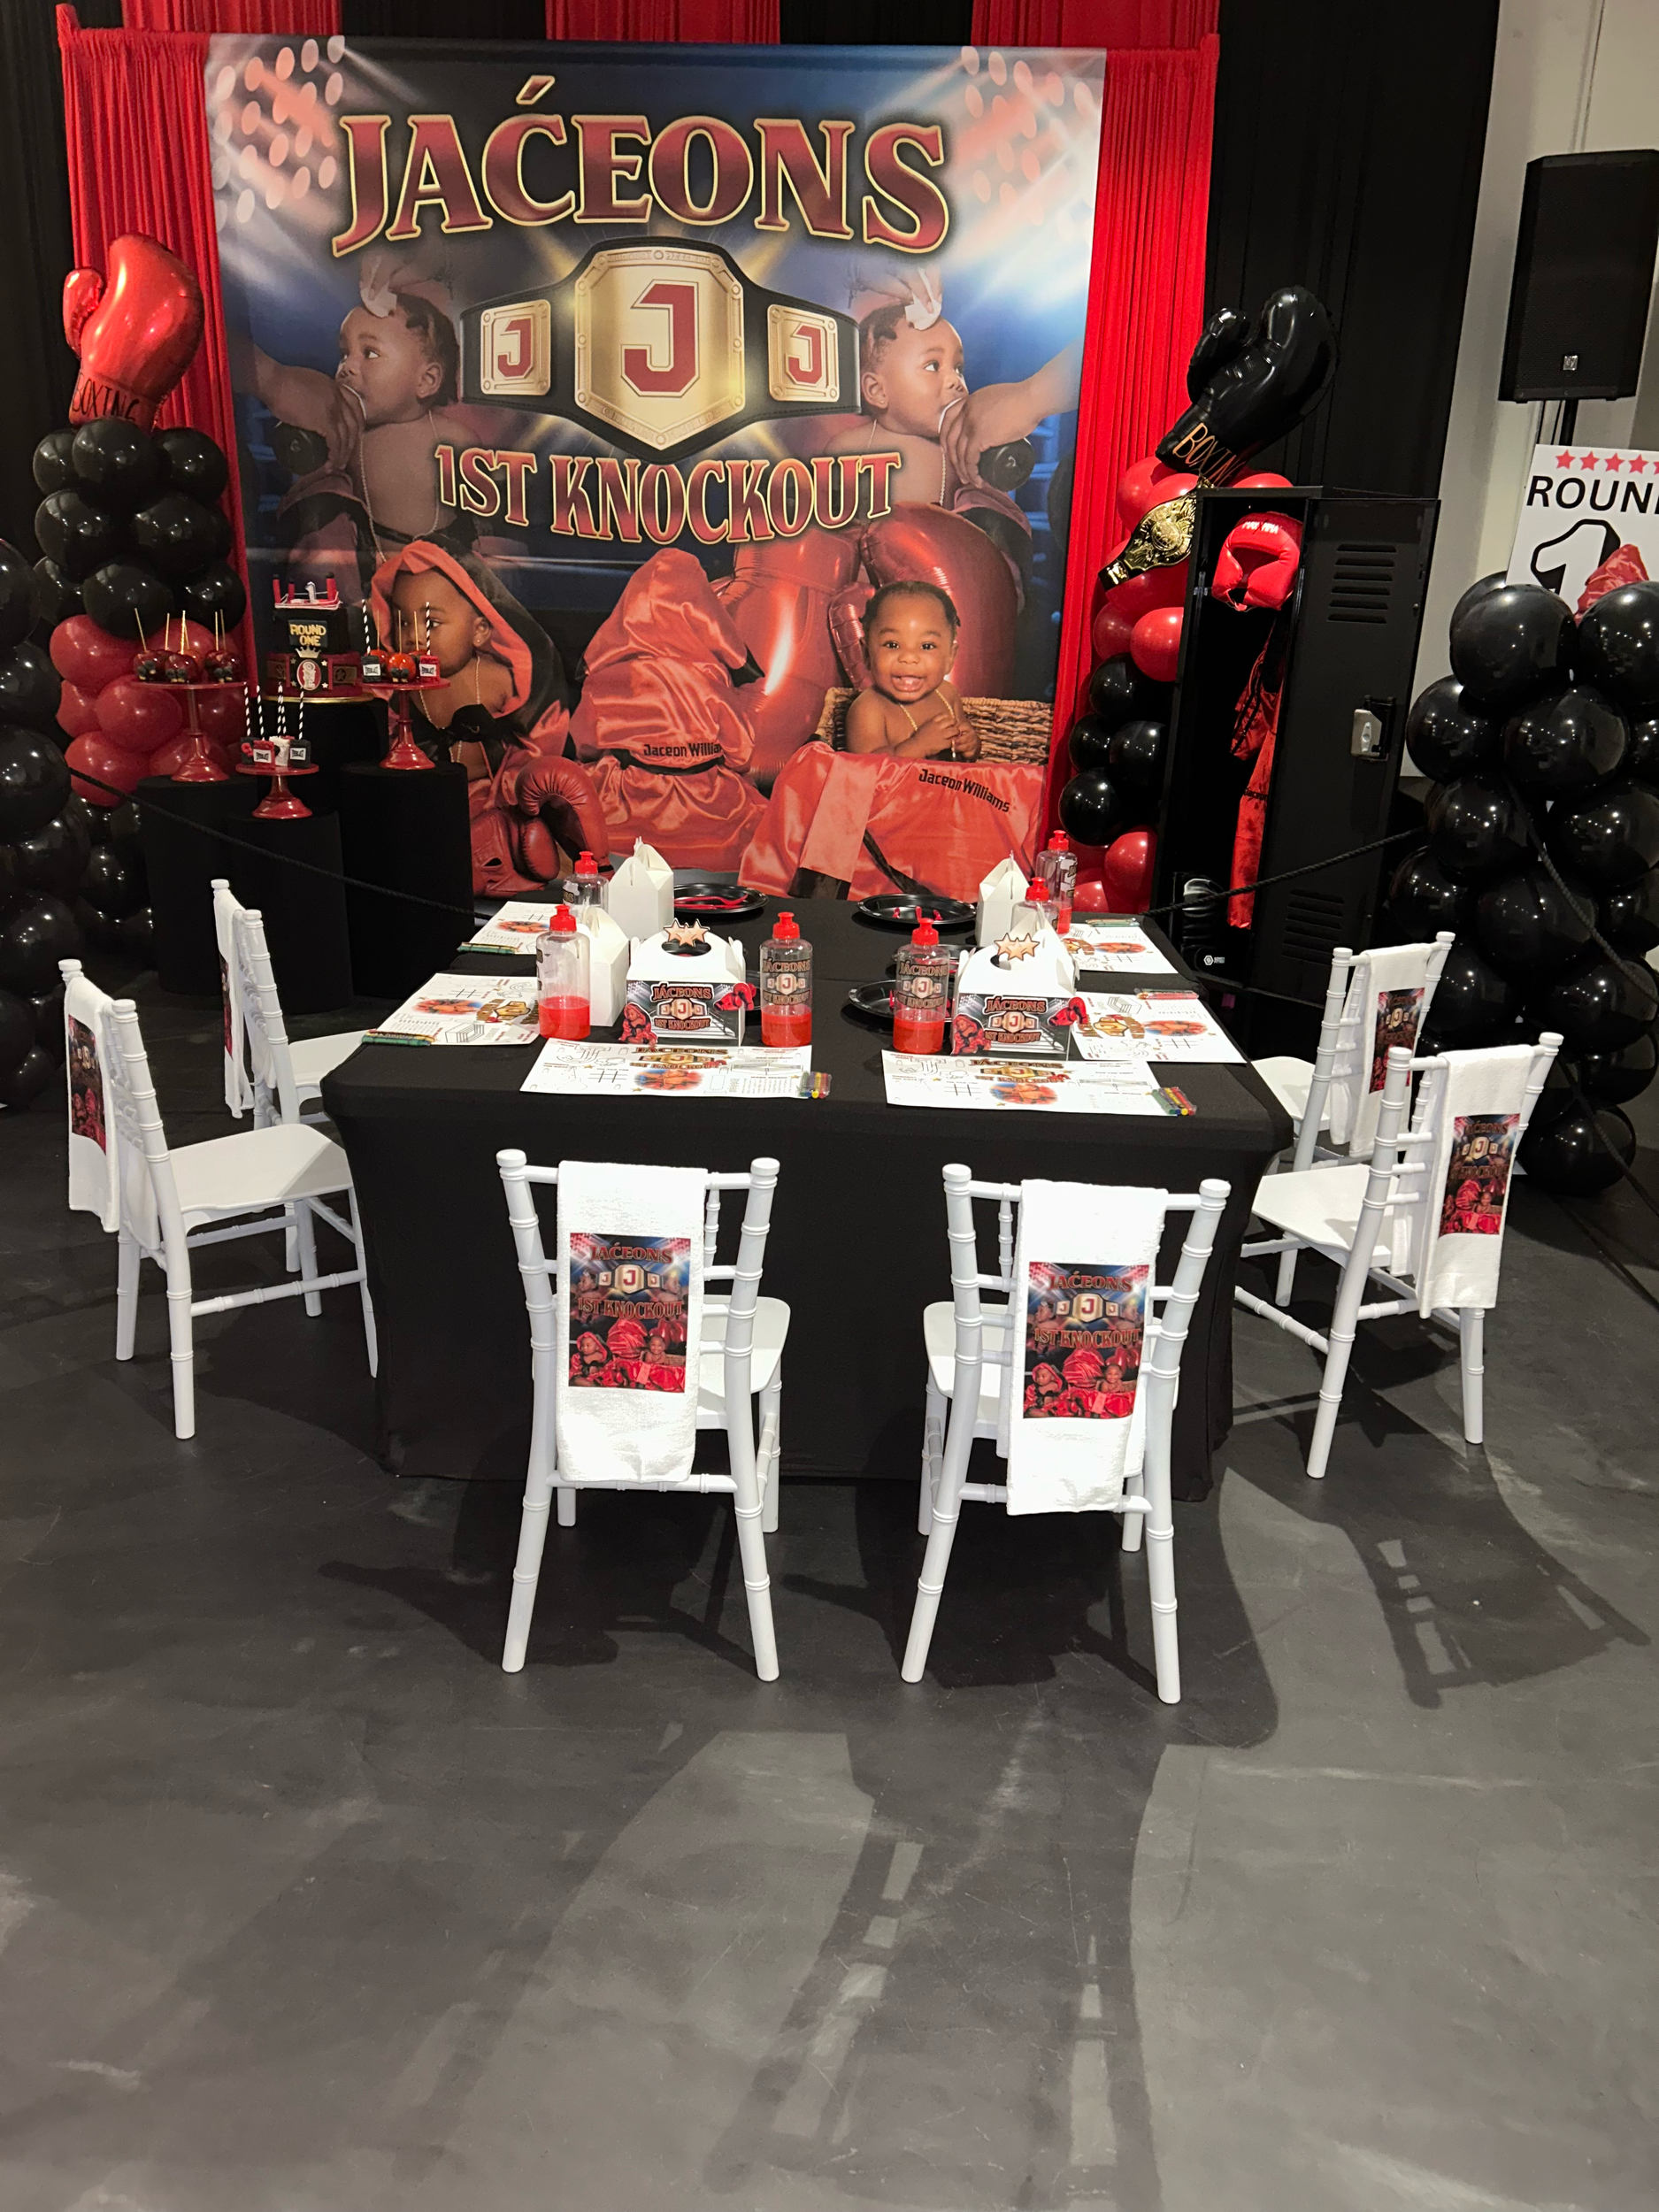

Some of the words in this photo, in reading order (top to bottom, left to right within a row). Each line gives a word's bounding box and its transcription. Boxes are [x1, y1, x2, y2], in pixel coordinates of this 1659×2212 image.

[332, 75, 949, 257] JAĆEONS
[495, 317, 534, 380] J
[620, 279, 700, 398] J
[785, 323, 825, 386] J
[434, 444, 537, 527] 1ST
[549, 451, 902, 545] KNOCKOUT
[1526, 475, 1659, 515] ROUN
[289, 624, 326, 635] ROUND
[299, 635, 321, 647] ONE
[643, 743, 687, 757] Jaceon
[688, 741, 723, 757] Willia
[918, 768, 963, 791] Jaceon
[963, 778, 1010, 812] Williams
[589, 1242, 673, 1263] JAĆEONS
[623, 1270, 636, 1286] J
[1048, 1271, 1133, 1293] JAĆEONS
[578, 1297, 602, 1315] 1ST
[603, 1300, 684, 1319] KNOCKOUT
[1081, 1298, 1094, 1315] J
[1034, 1328, 1058, 1346] 1ST
[1060, 1328, 1141, 1349] KNOCKOUT
